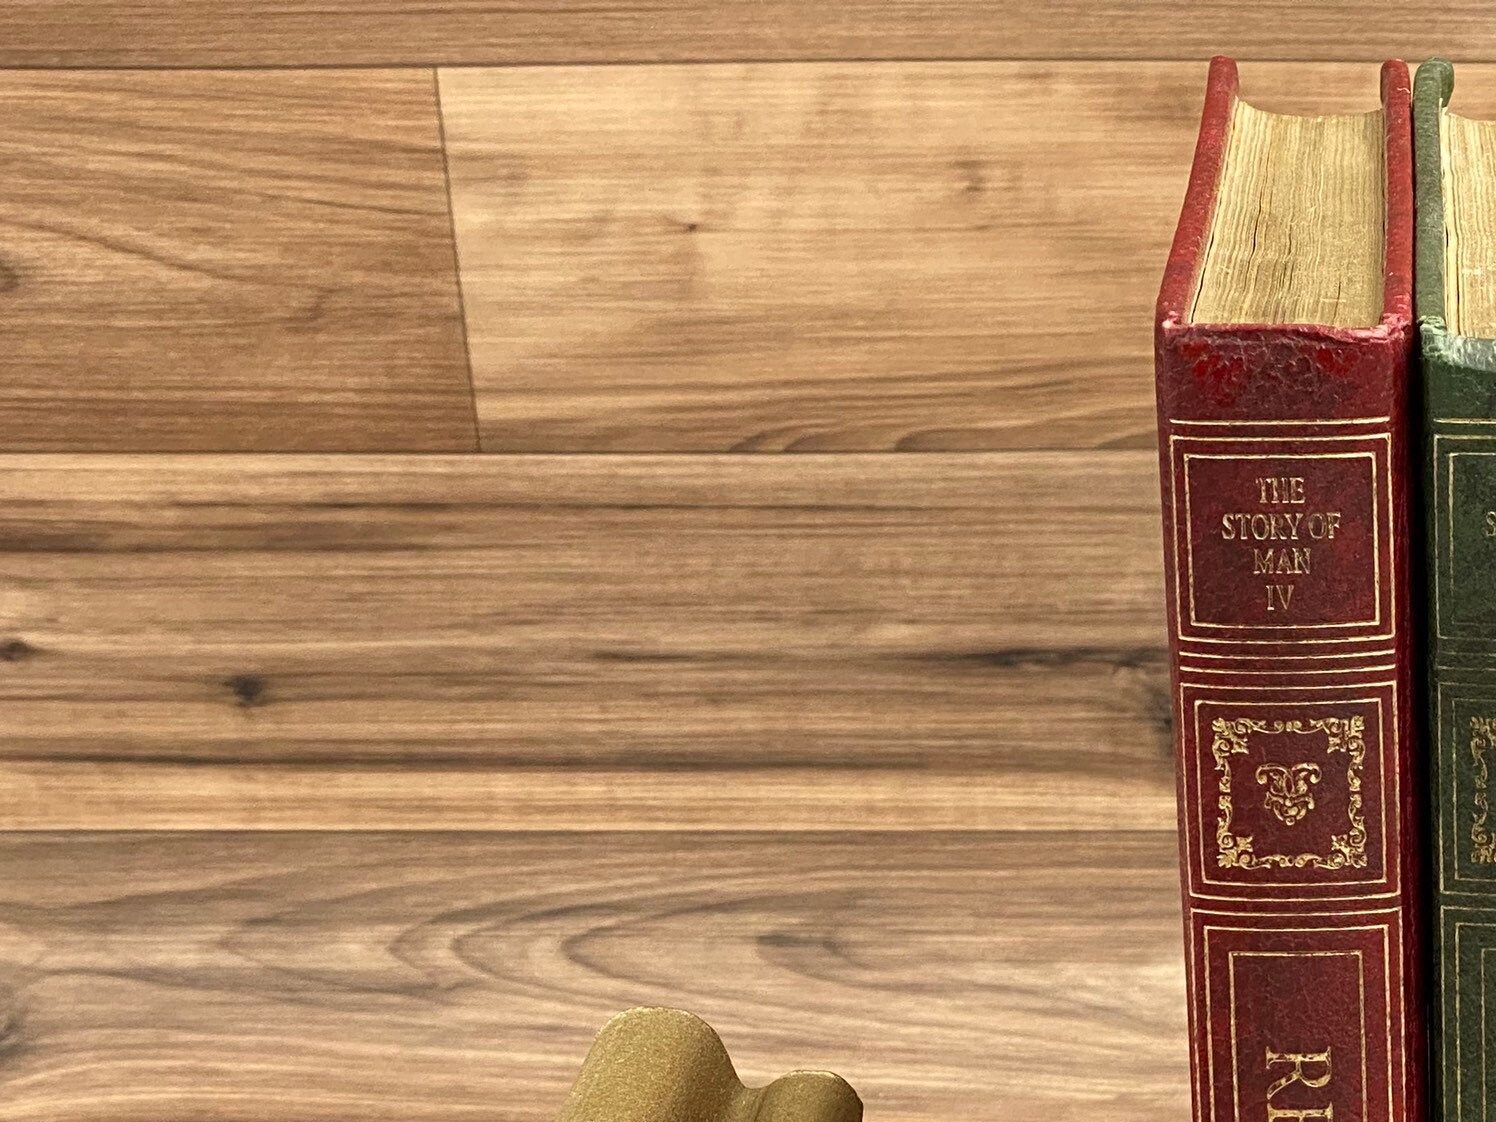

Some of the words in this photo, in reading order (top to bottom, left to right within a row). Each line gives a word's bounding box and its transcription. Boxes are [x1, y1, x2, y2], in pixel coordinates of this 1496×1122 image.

[1255, 477, 1306, 504] THE
[1221, 512, 1303, 541] STORY
[1307, 511, 1342, 540] OF
[1252, 547, 1312, 575] MAN
[1265, 584, 1295, 611] IV
